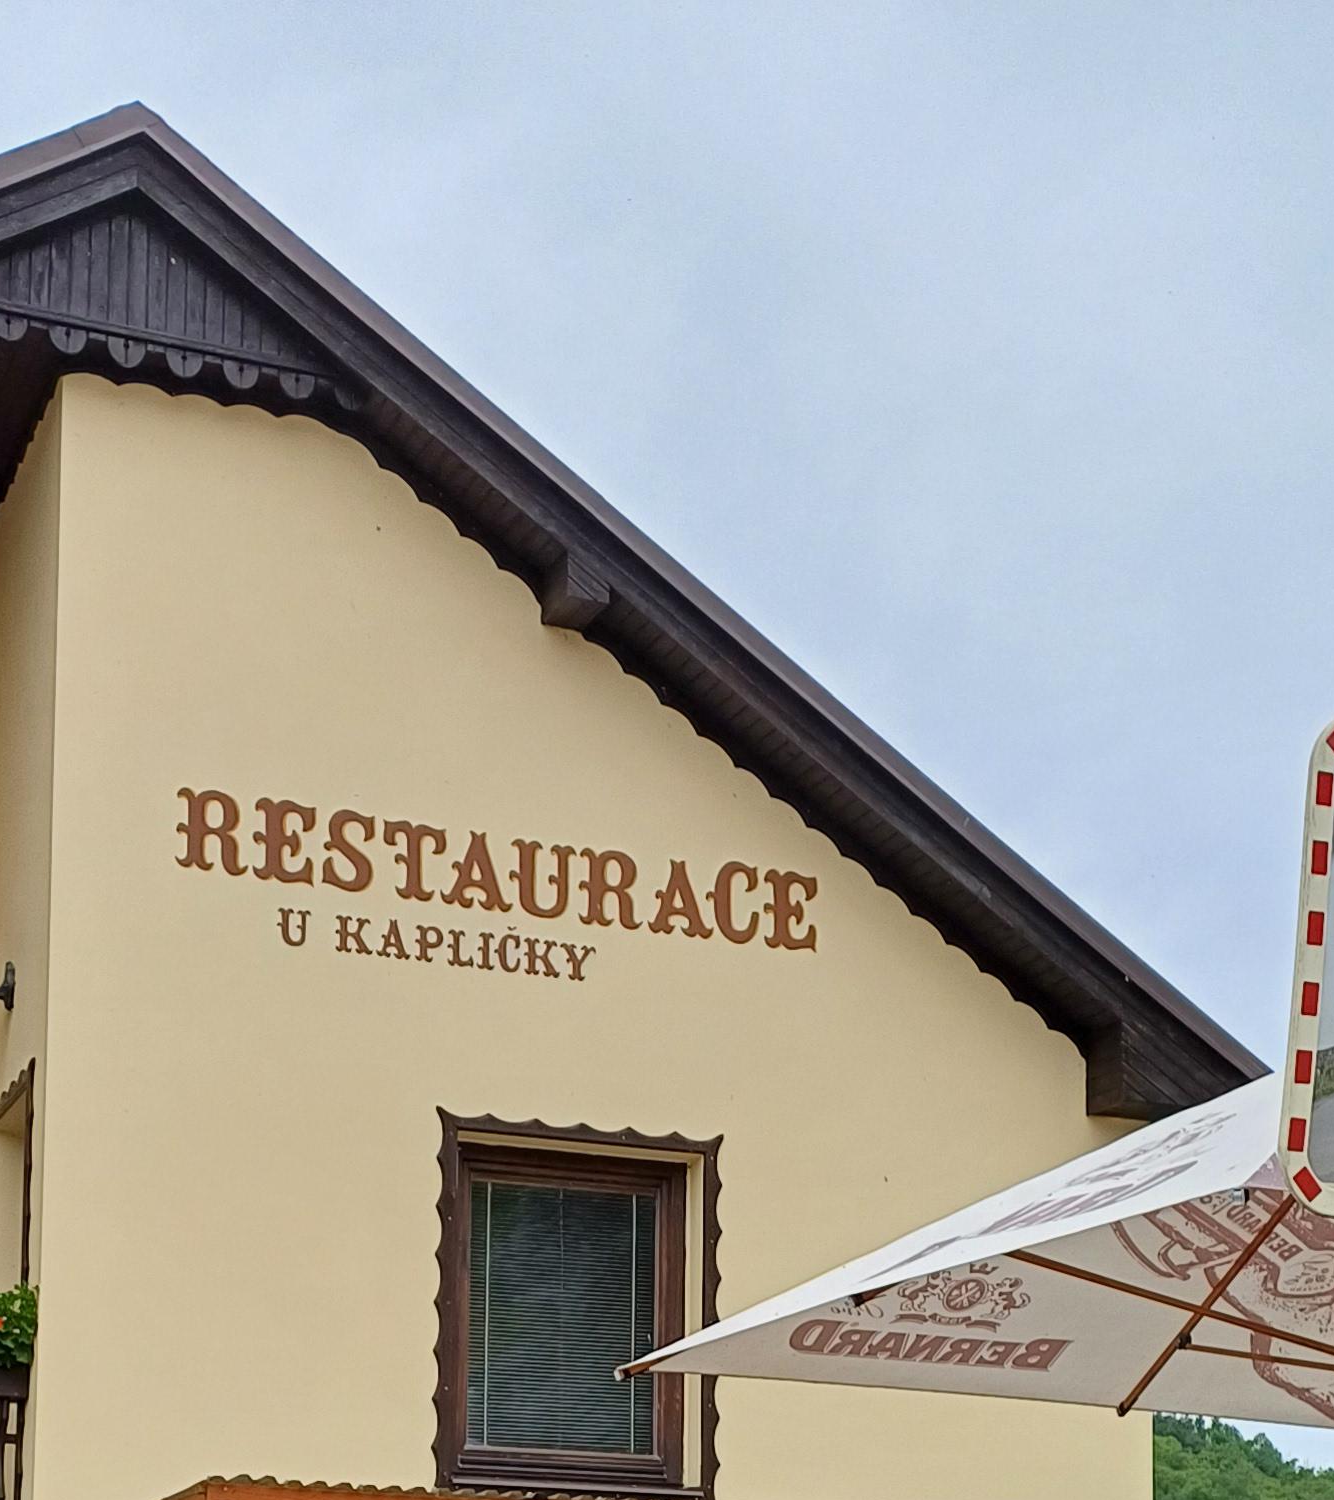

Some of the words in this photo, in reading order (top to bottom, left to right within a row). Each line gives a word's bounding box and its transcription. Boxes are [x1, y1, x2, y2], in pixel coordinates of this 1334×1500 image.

[175, 787, 818, 952] RESTAURACE
[277, 907, 310, 946] U
[335, 912, 596, 981] KAPLIČKY
